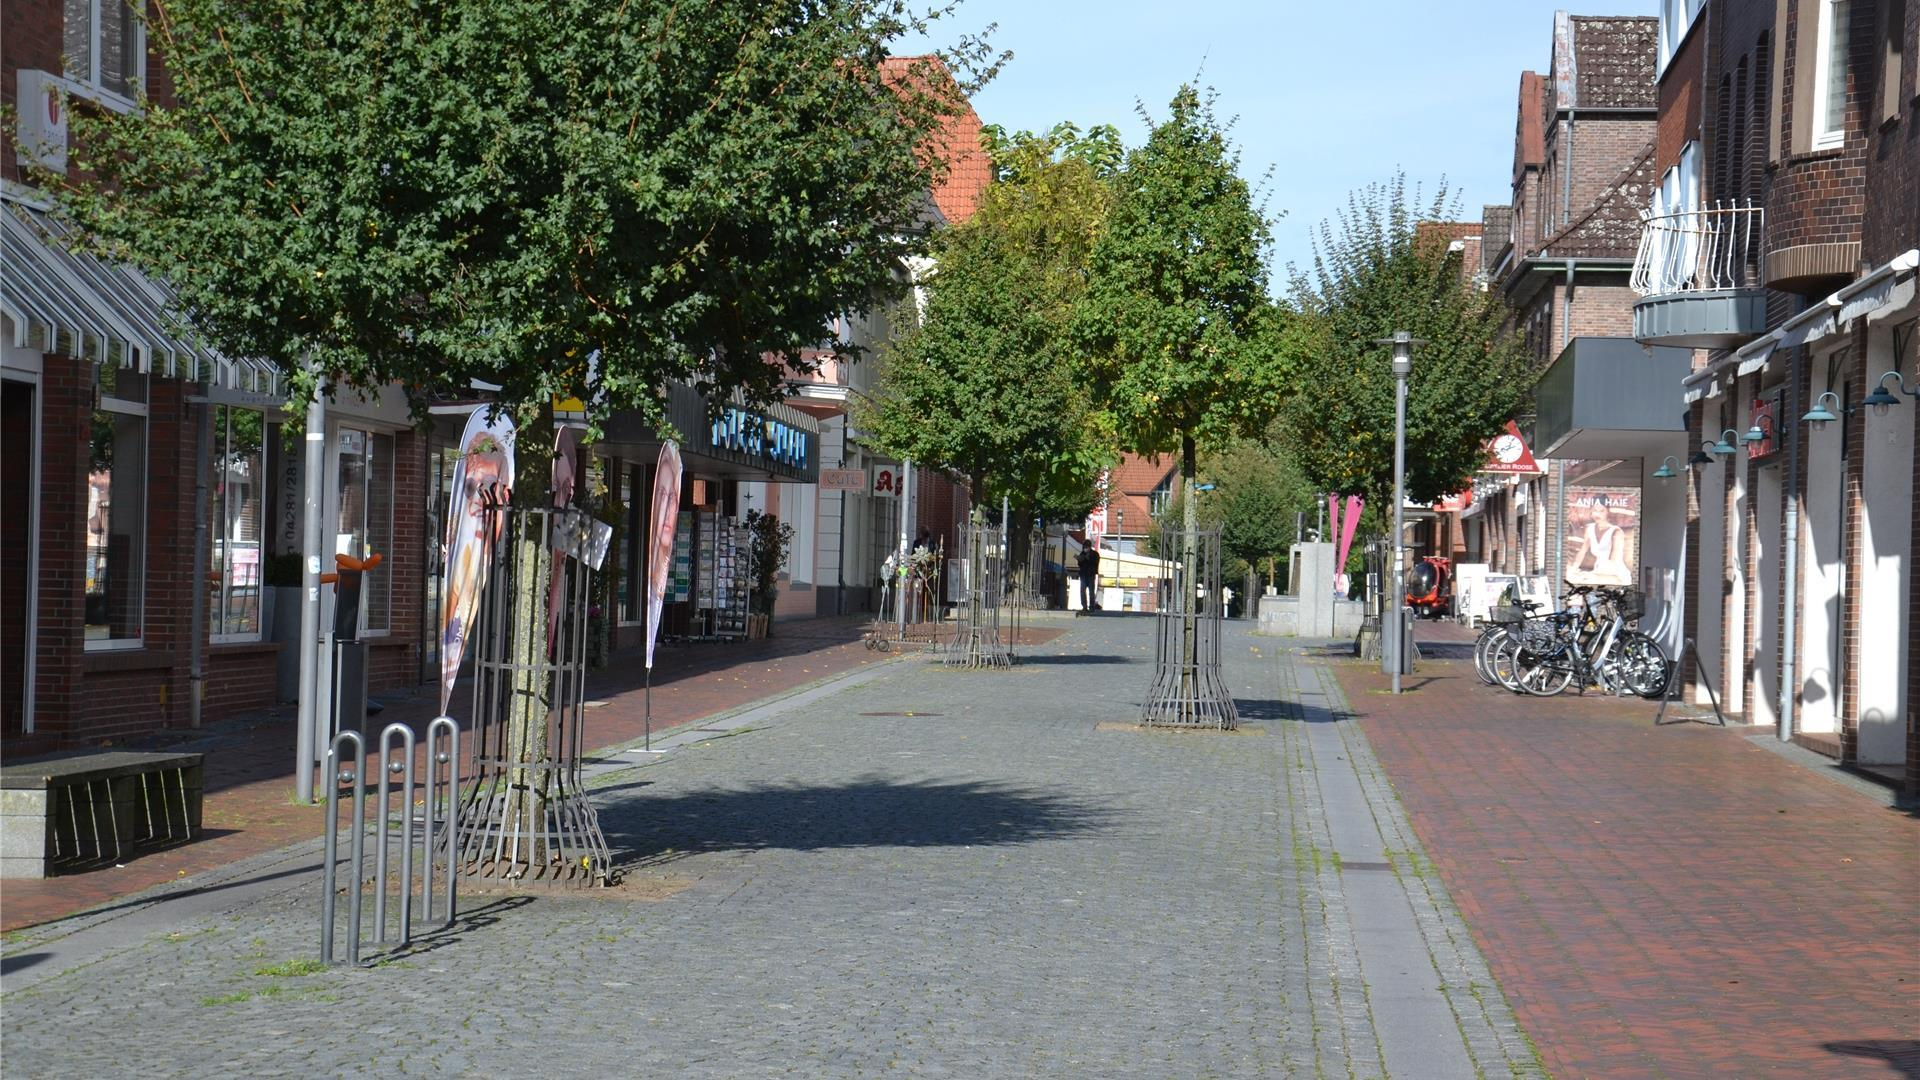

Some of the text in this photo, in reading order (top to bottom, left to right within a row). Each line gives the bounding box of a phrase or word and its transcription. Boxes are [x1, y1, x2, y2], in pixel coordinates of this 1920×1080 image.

[1512, 463, 1534, 471] ROOSE
[1576, 498, 1629, 507] ANIA HAIE
